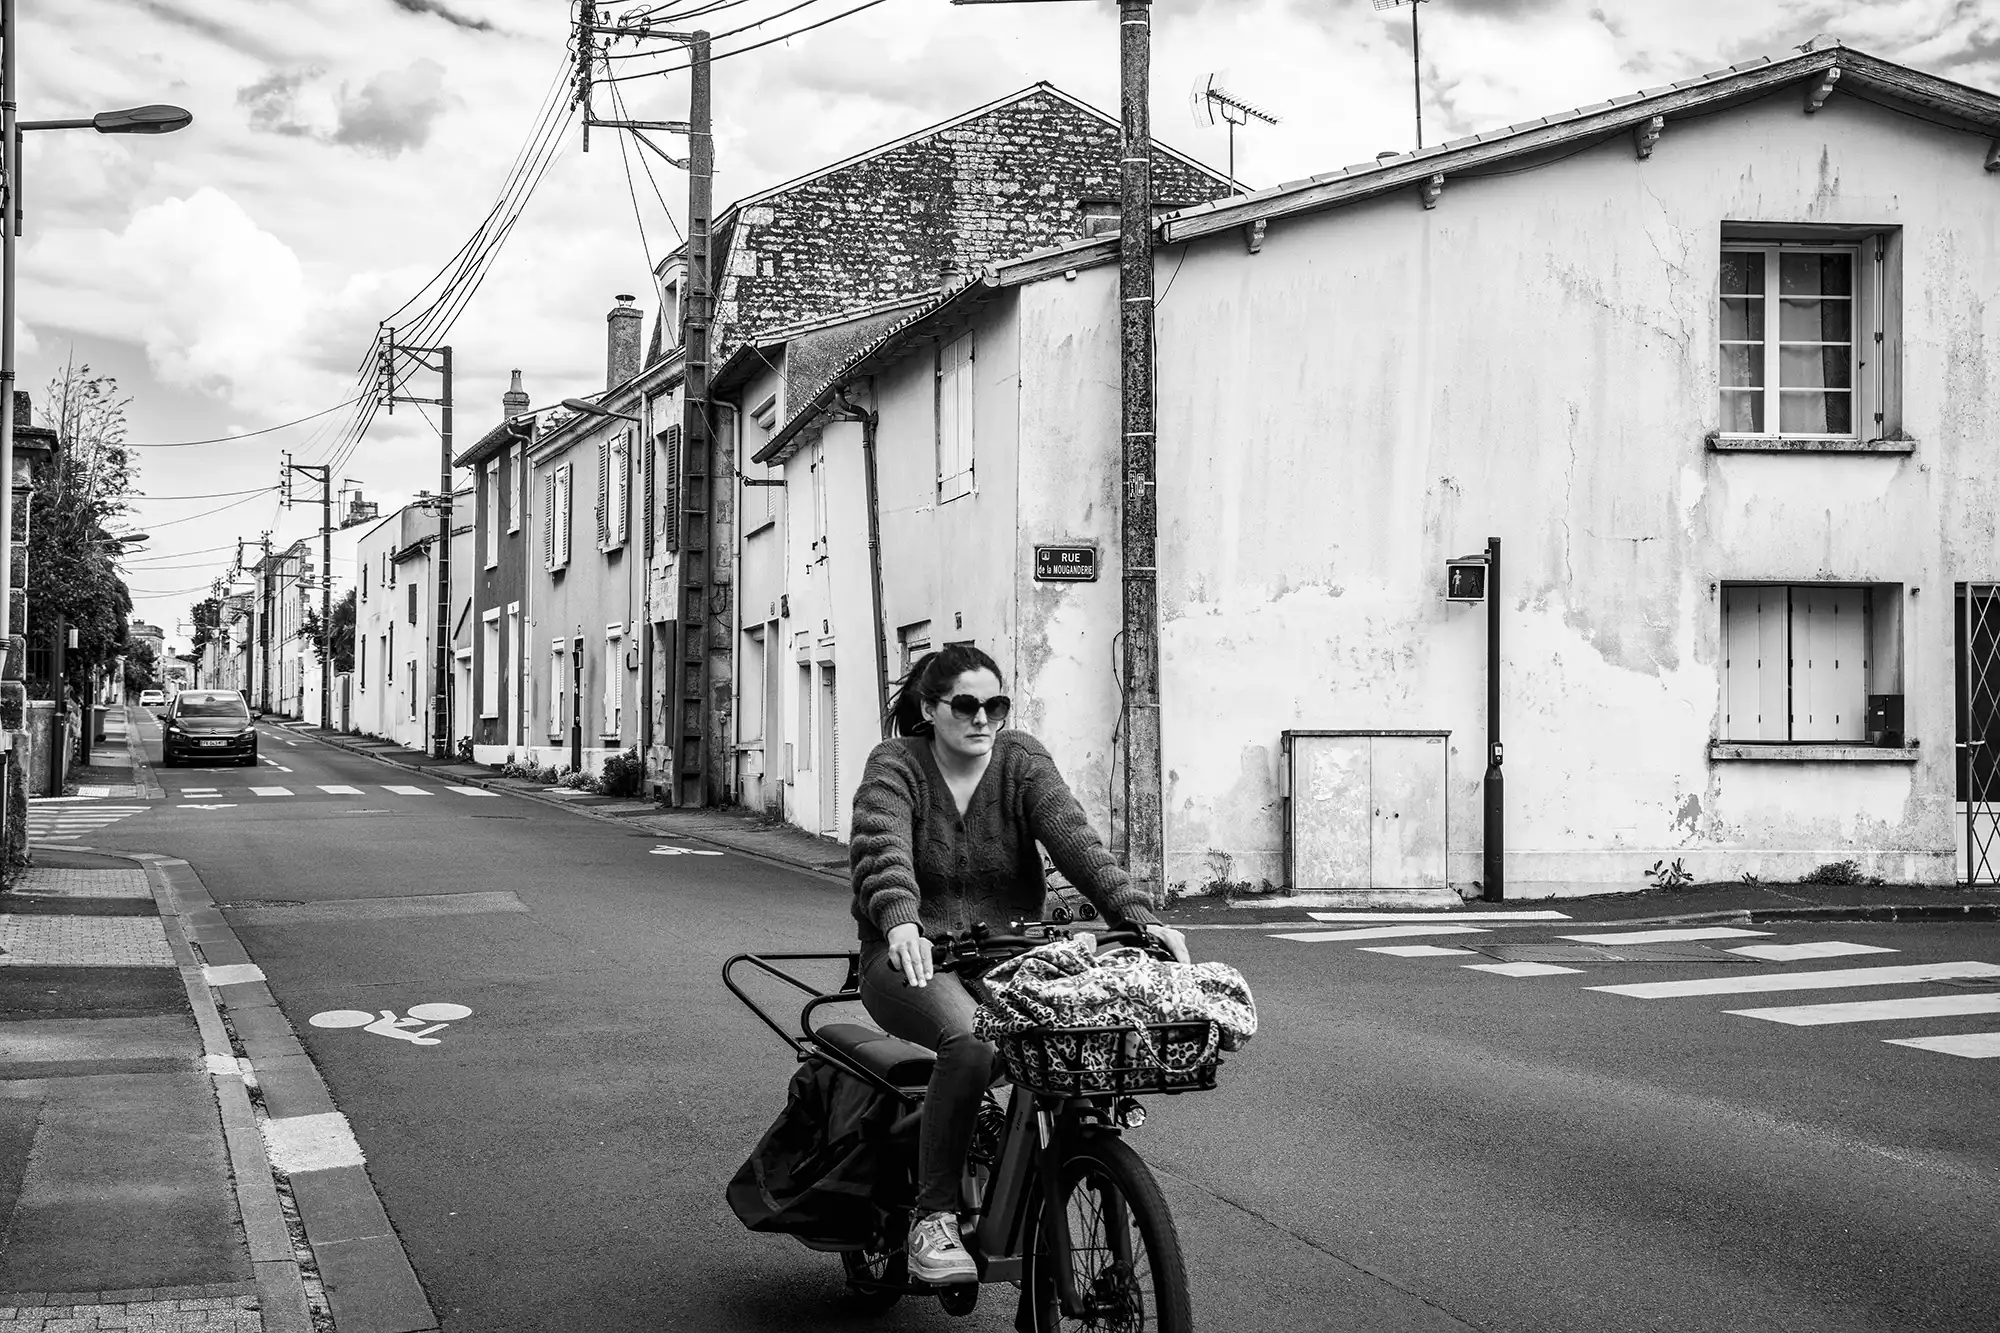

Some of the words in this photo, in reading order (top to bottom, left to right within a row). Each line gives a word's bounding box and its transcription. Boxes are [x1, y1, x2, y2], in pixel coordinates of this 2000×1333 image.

[1061, 553, 1080, 562] RUE
[1038, 565, 1045, 574] de
[1046, 565, 1052, 574] la
[1053, 565, 1093, 574] MOUGANDERIE
